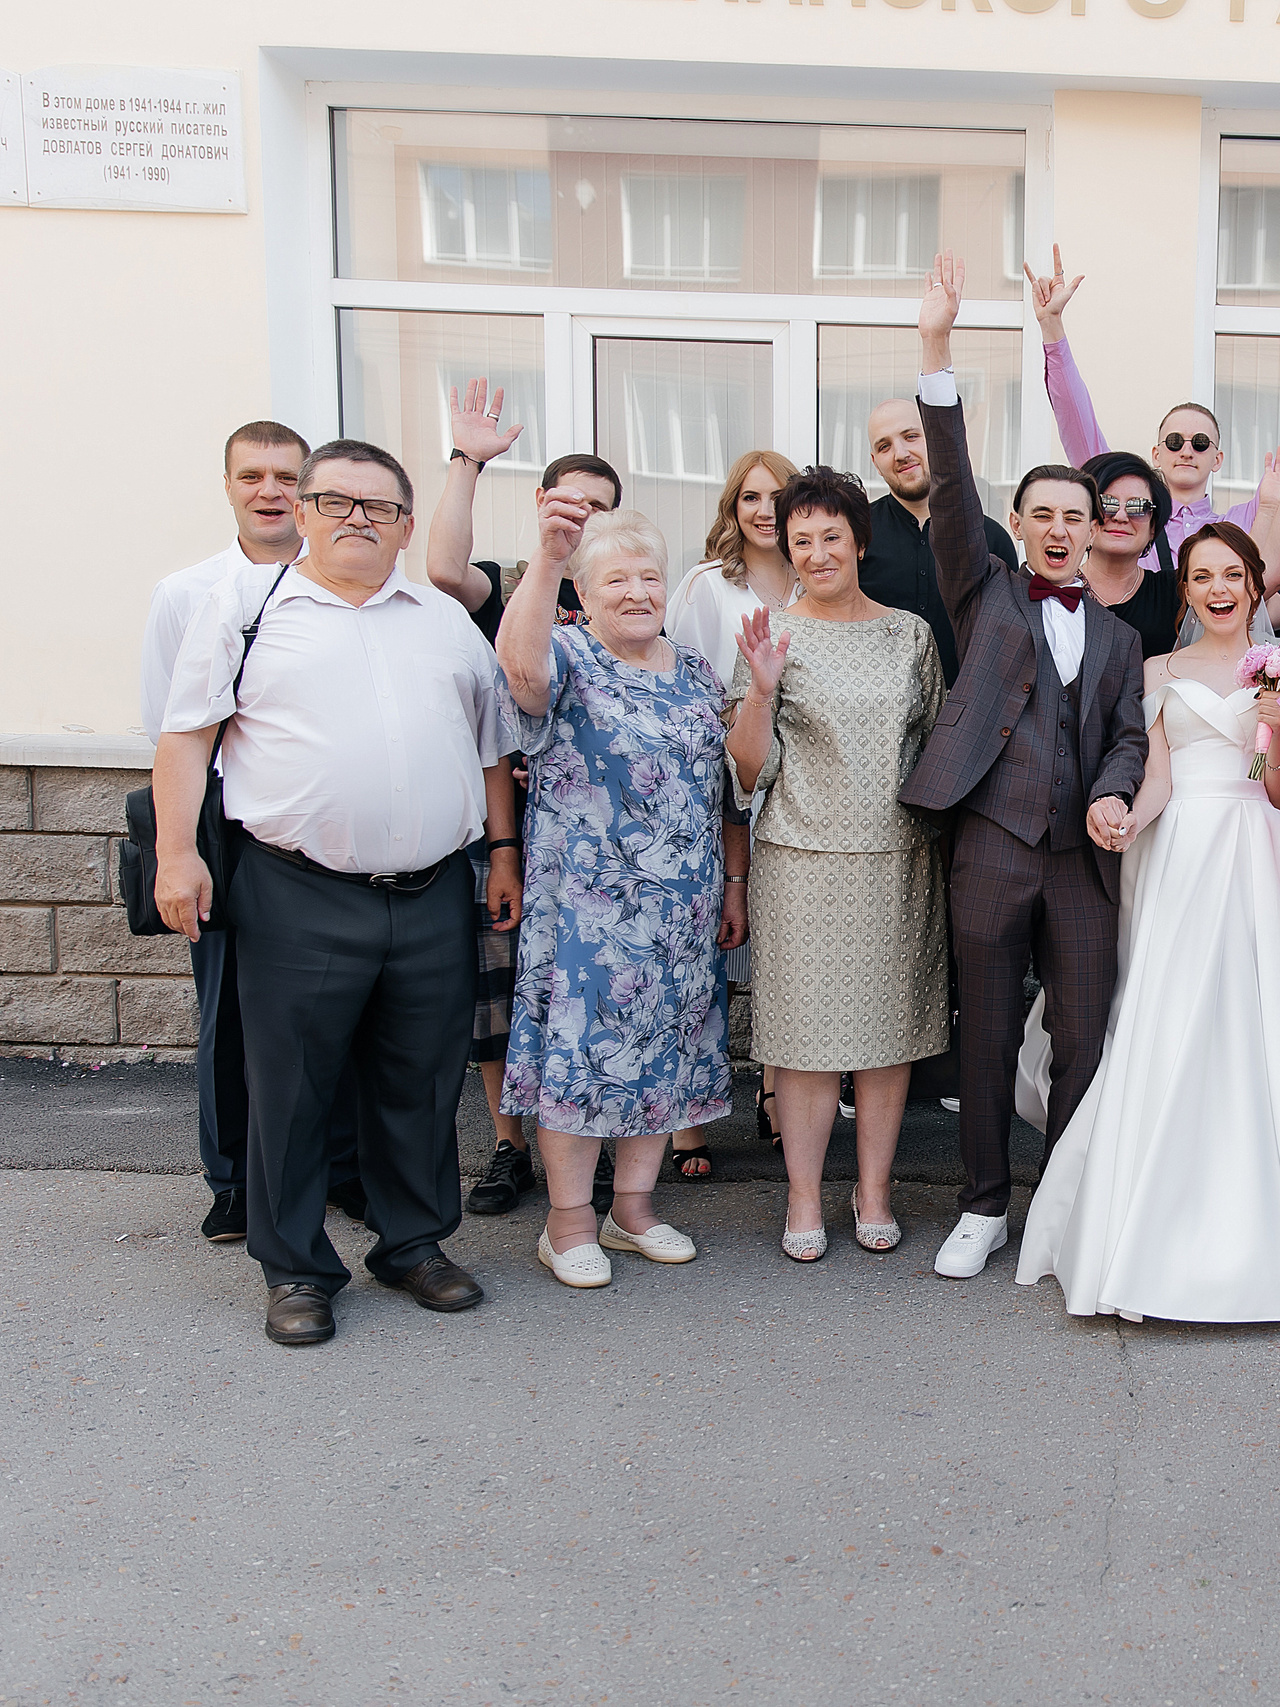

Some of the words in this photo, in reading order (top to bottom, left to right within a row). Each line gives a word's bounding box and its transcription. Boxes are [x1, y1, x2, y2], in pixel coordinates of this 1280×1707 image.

[42, 91, 50, 108] В
[54, 96, 82, 110] этом
[85, 97, 116, 113] доме
[120, 99, 126, 111] в
[129, 97, 182, 114] 1941-1944
[185, 102, 200, 115] г.г.
[202, 102, 226, 116] жил
[42, 115, 108, 132] известный
[115, 118, 164, 137] русский
[171, 122, 228, 137] писатель
[42, 139, 102, 156] ДОВЛАТОВ
[110, 140, 153, 158] СЕРГЕЙ
[161, 143, 229, 161] ДОНАТОВИЧ
[103, 165, 131, 183] (1941
[142, 166, 170, 185] 1990)
